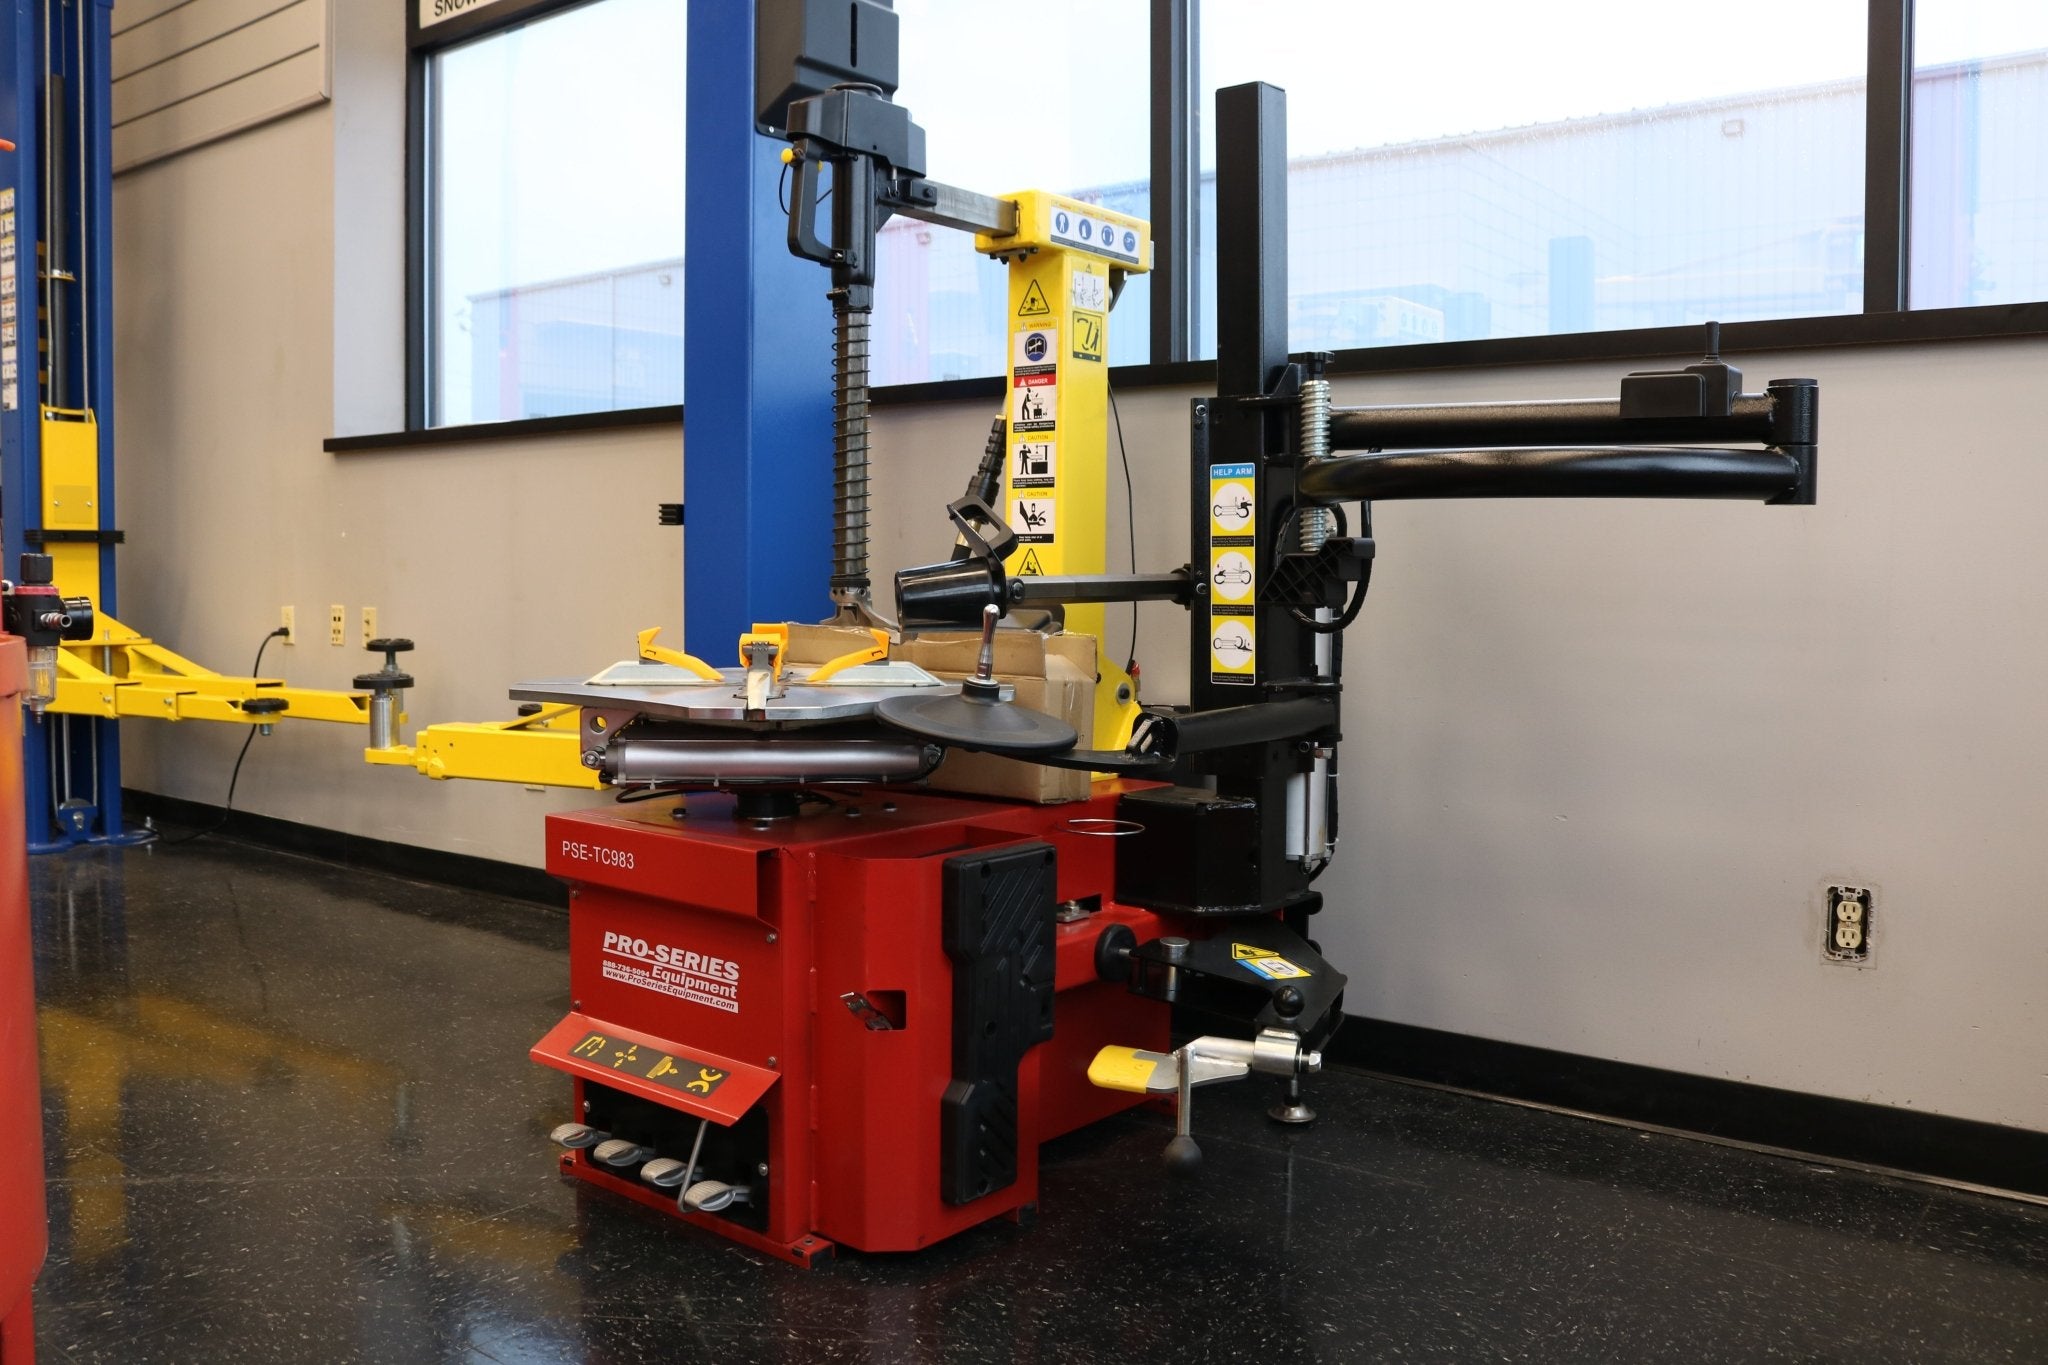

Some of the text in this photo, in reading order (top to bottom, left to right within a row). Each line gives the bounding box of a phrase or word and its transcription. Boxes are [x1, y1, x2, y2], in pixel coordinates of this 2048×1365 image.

[1213, 467, 1252, 476] HELP ARM
[562, 840, 635, 870] PSE-TC983
[603, 930, 740, 981] PRO-SERIES
[605, 968, 735, 1010] www.ProSeriesEquipment.com
[652, 965, 738, 999] Equipment
